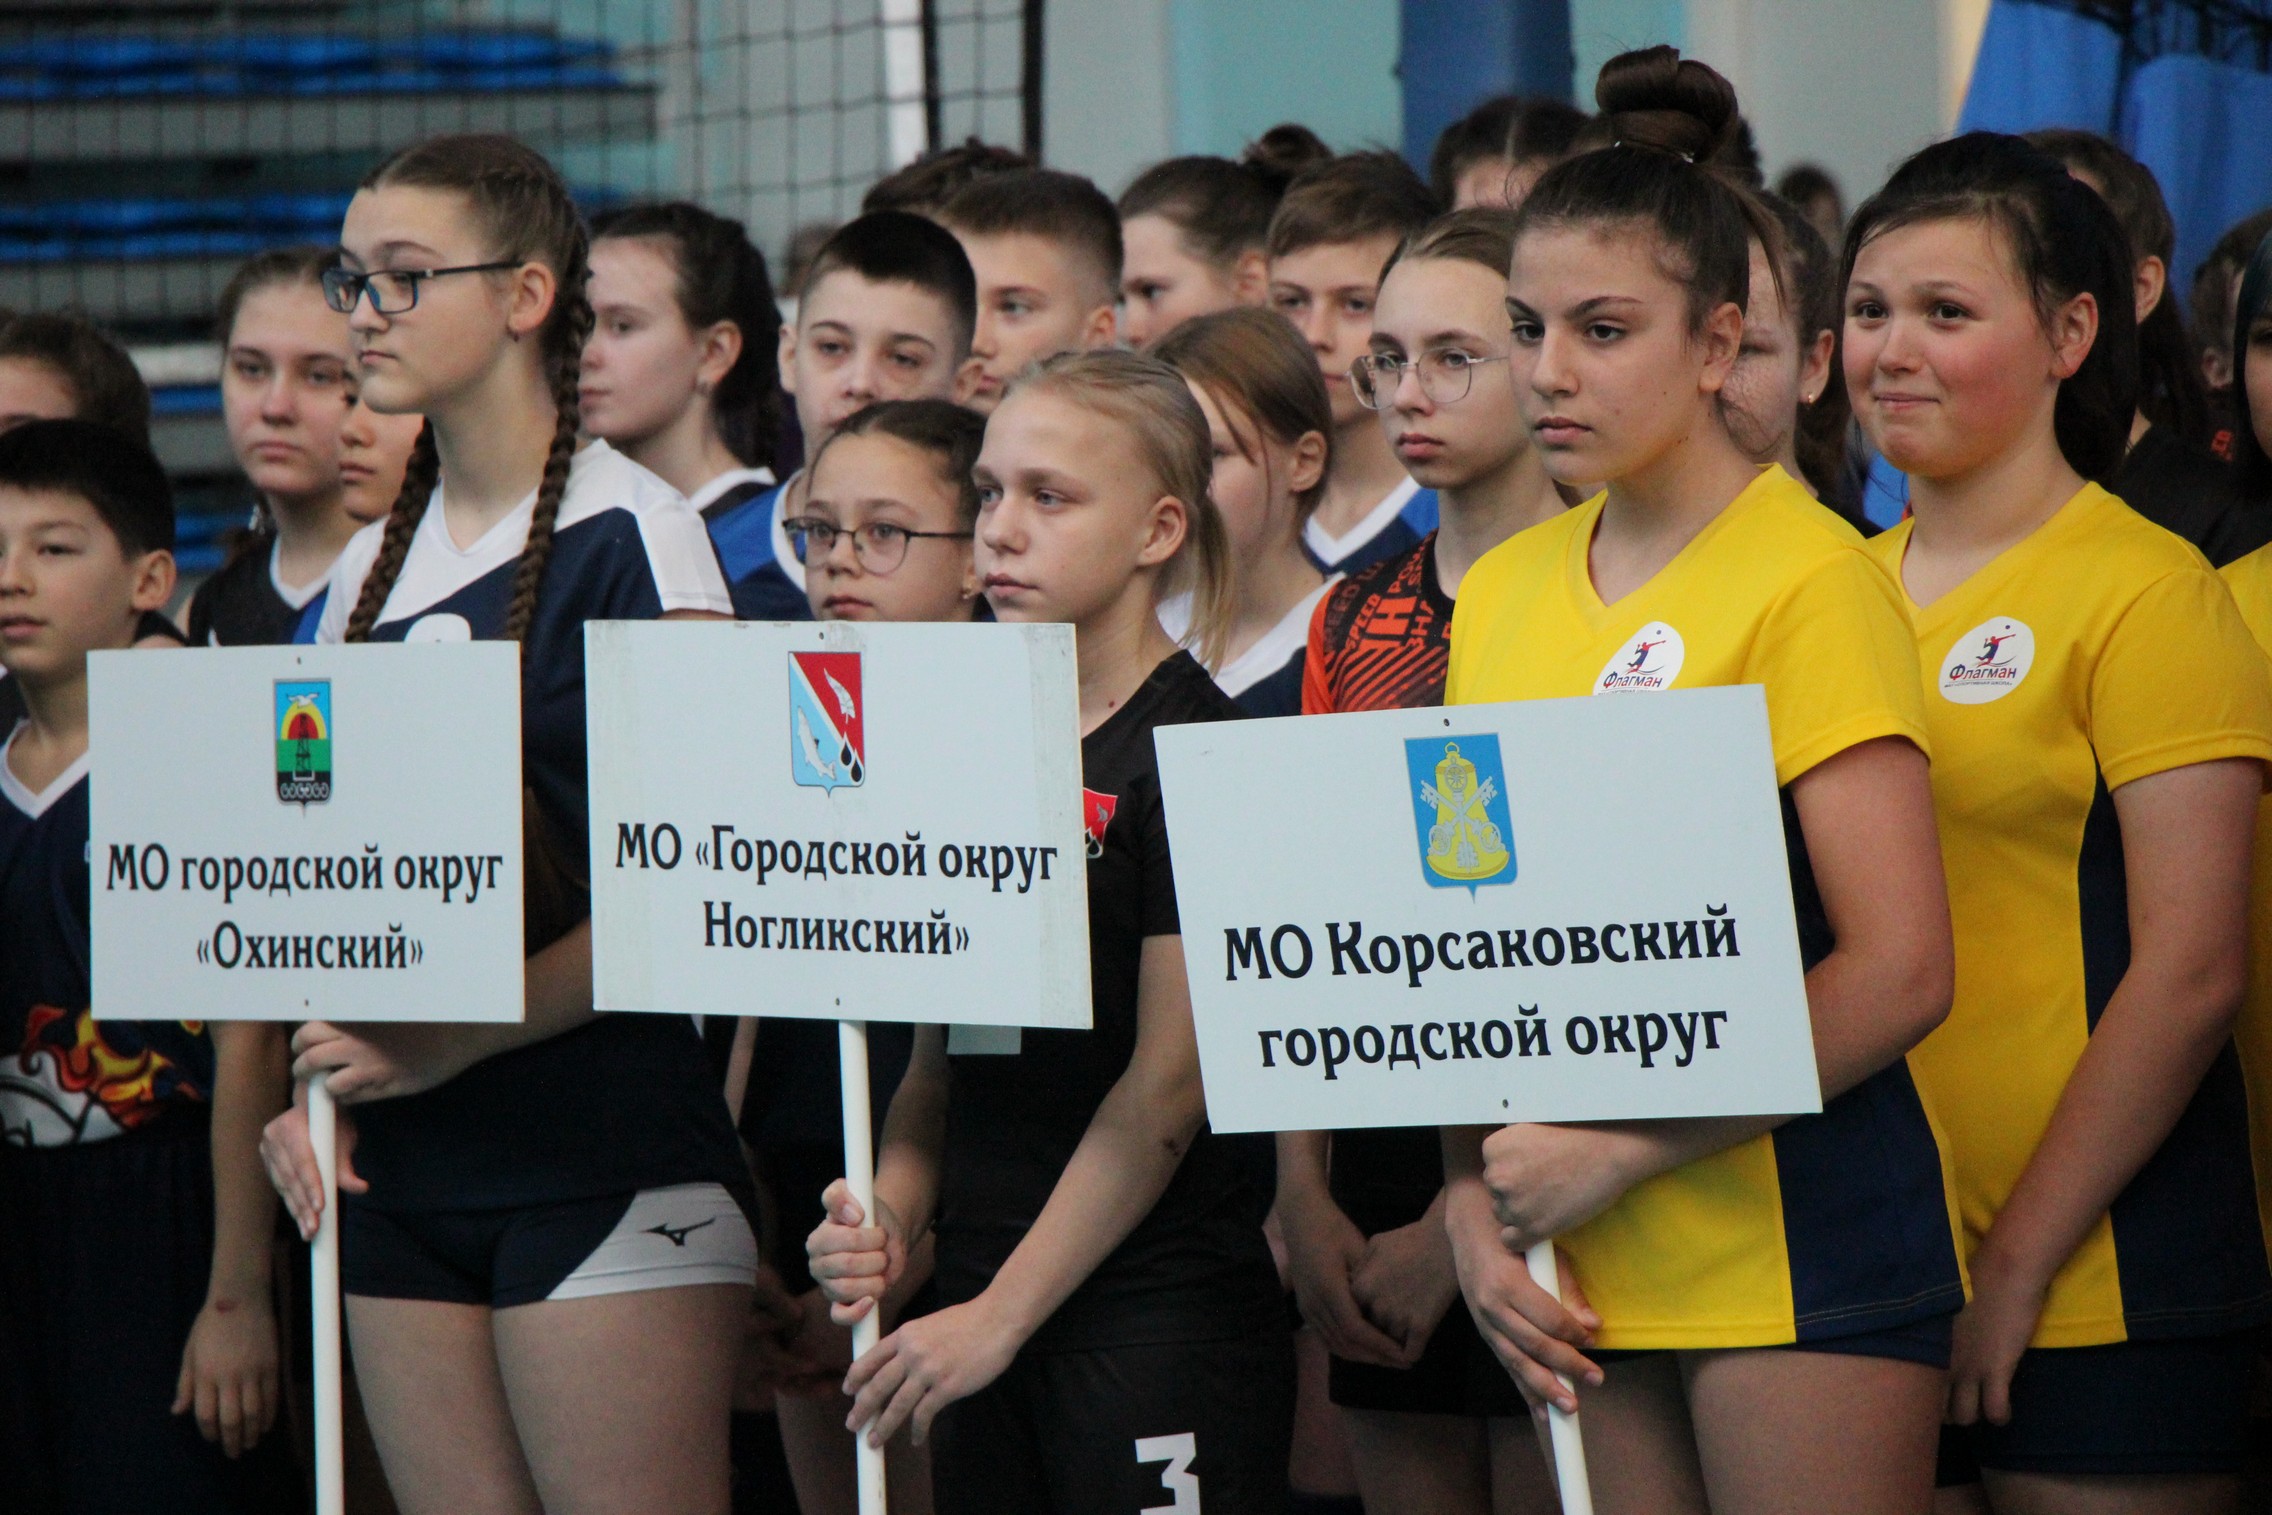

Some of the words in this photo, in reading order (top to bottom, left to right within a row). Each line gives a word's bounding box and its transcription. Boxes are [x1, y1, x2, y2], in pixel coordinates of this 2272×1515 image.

[1603, 671, 1663, 688] Флагман
[1950, 664, 2017, 681] Флагман
[107, 843, 170, 891] МО
[182, 843, 383, 904] городской
[395, 855, 503, 904] округ
[616, 823, 682, 870] МО
[696, 825, 927, 886] «Городской
[938, 844, 1058, 893] округ
[198, 921, 423, 969] «Охинский»
[703, 901, 971, 955] Ногликский»
[1224, 924, 1313, 981] МО
[1326, 903, 1741, 987] Корсаковский
[1258, 1004, 1552, 1080] городской
[1566, 1011, 1728, 1069] округ
[1136, 1432, 1200, 1515] 3
